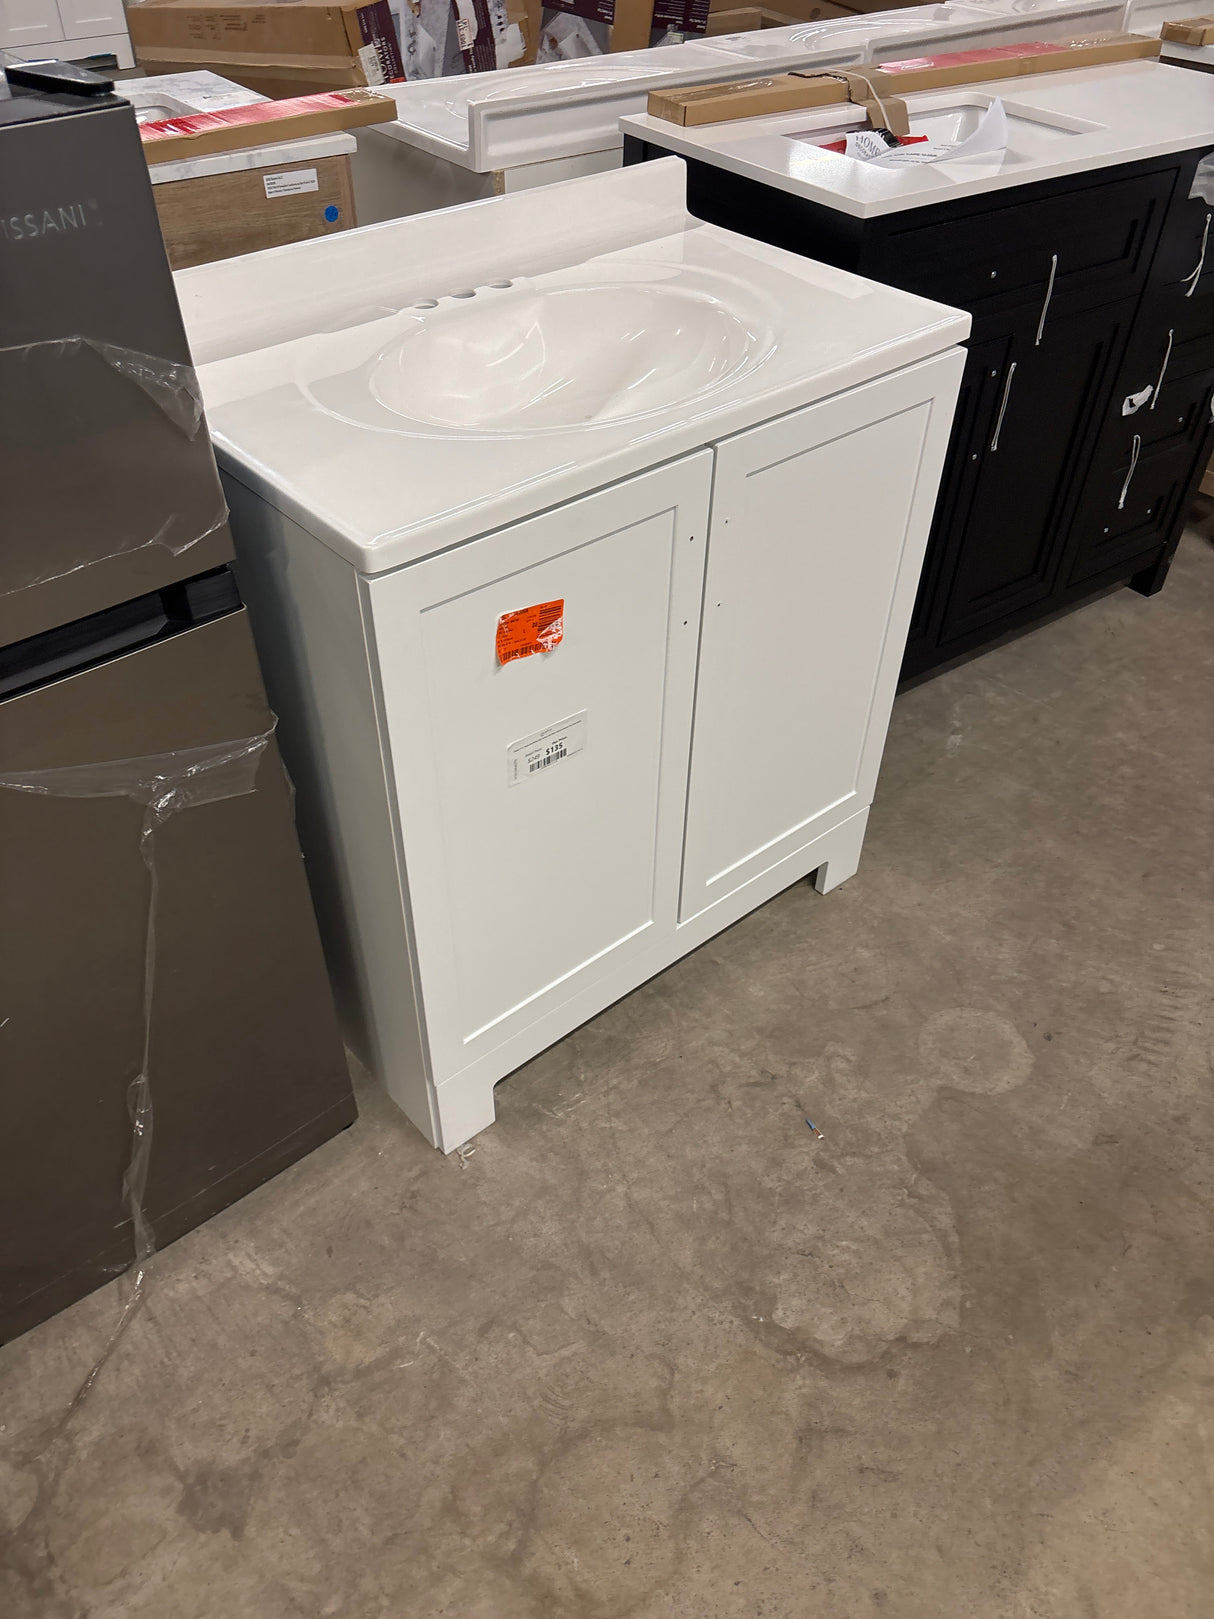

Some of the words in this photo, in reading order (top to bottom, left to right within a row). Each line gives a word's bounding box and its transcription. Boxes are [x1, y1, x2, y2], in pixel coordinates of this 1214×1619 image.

[380, 36, 394, 79] ECORATORS
[0, 204, 86, 240] ISSANI
[545, 741, 563, 756] $135
